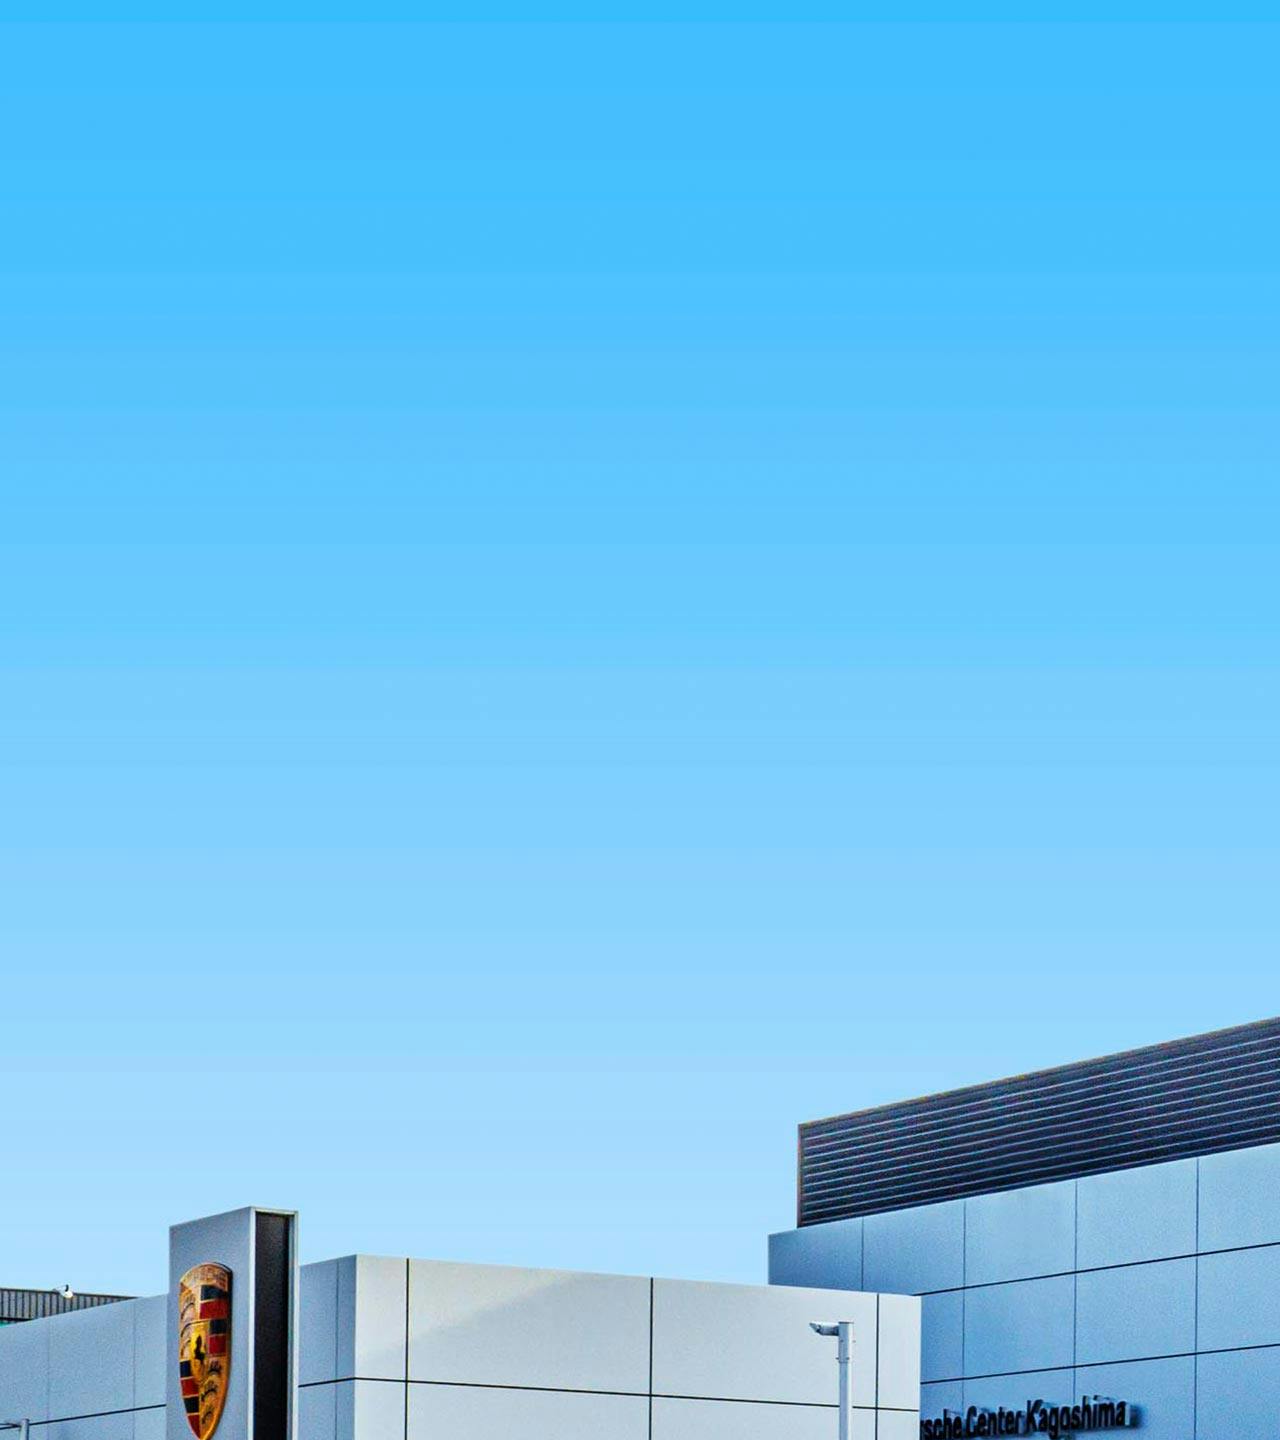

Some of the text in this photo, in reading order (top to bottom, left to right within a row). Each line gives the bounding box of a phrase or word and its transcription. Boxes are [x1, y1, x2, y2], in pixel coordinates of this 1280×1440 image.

[920, 1395, 1130, 1440] rsche Center Kagoshima
